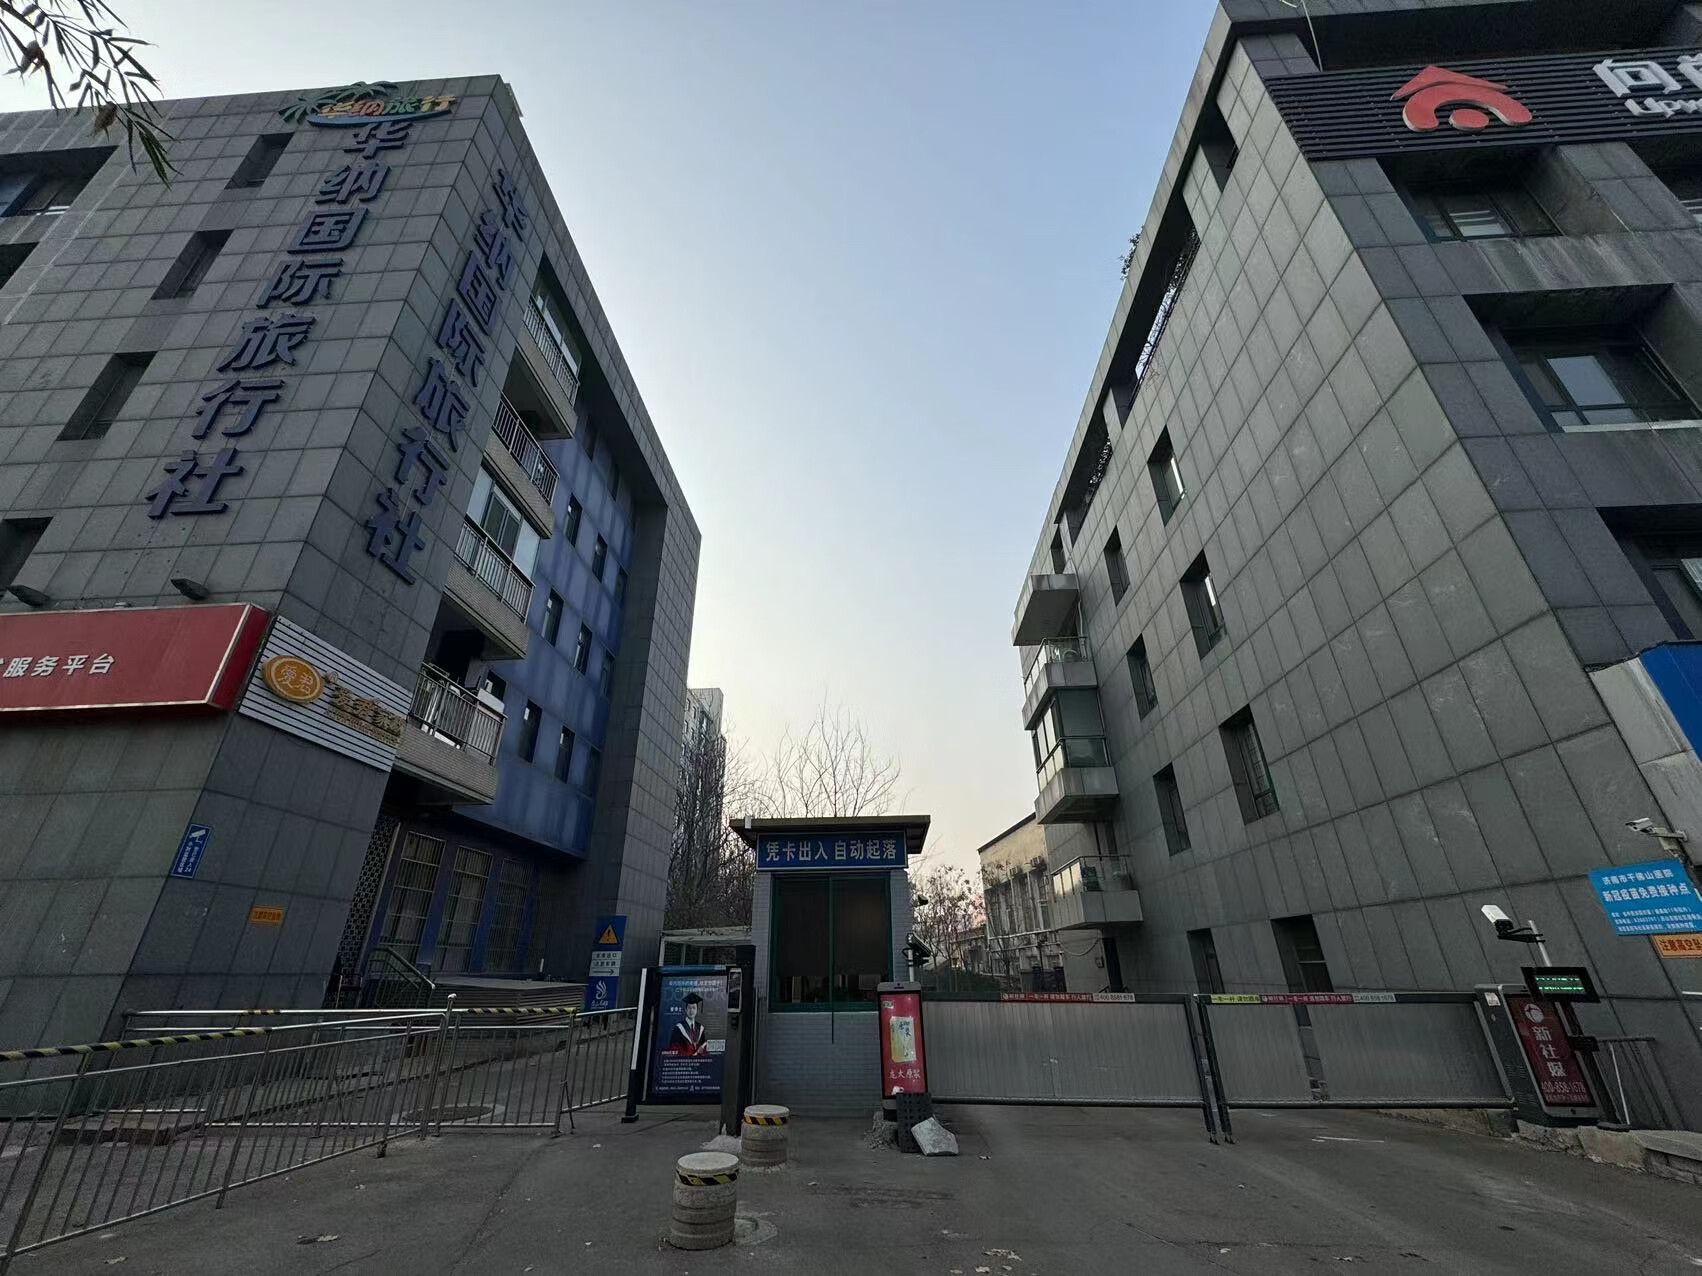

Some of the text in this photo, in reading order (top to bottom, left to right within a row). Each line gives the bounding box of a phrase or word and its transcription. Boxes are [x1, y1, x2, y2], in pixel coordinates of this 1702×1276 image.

[317, 95, 458, 118] 华纳旅行
[145, 121, 413, 520] 华纳国际旅行社
[364, 169, 528, 585] 华纳国际旅行社
[0, 653, 115, 677] 服务平台
[766, 839, 897, 861] 凭卡出入 自动起落
[1602, 869, 1674, 885] 济南市千佛山医院
[1602, 882, 1691, 902] 新冠疫苗免费接种点
